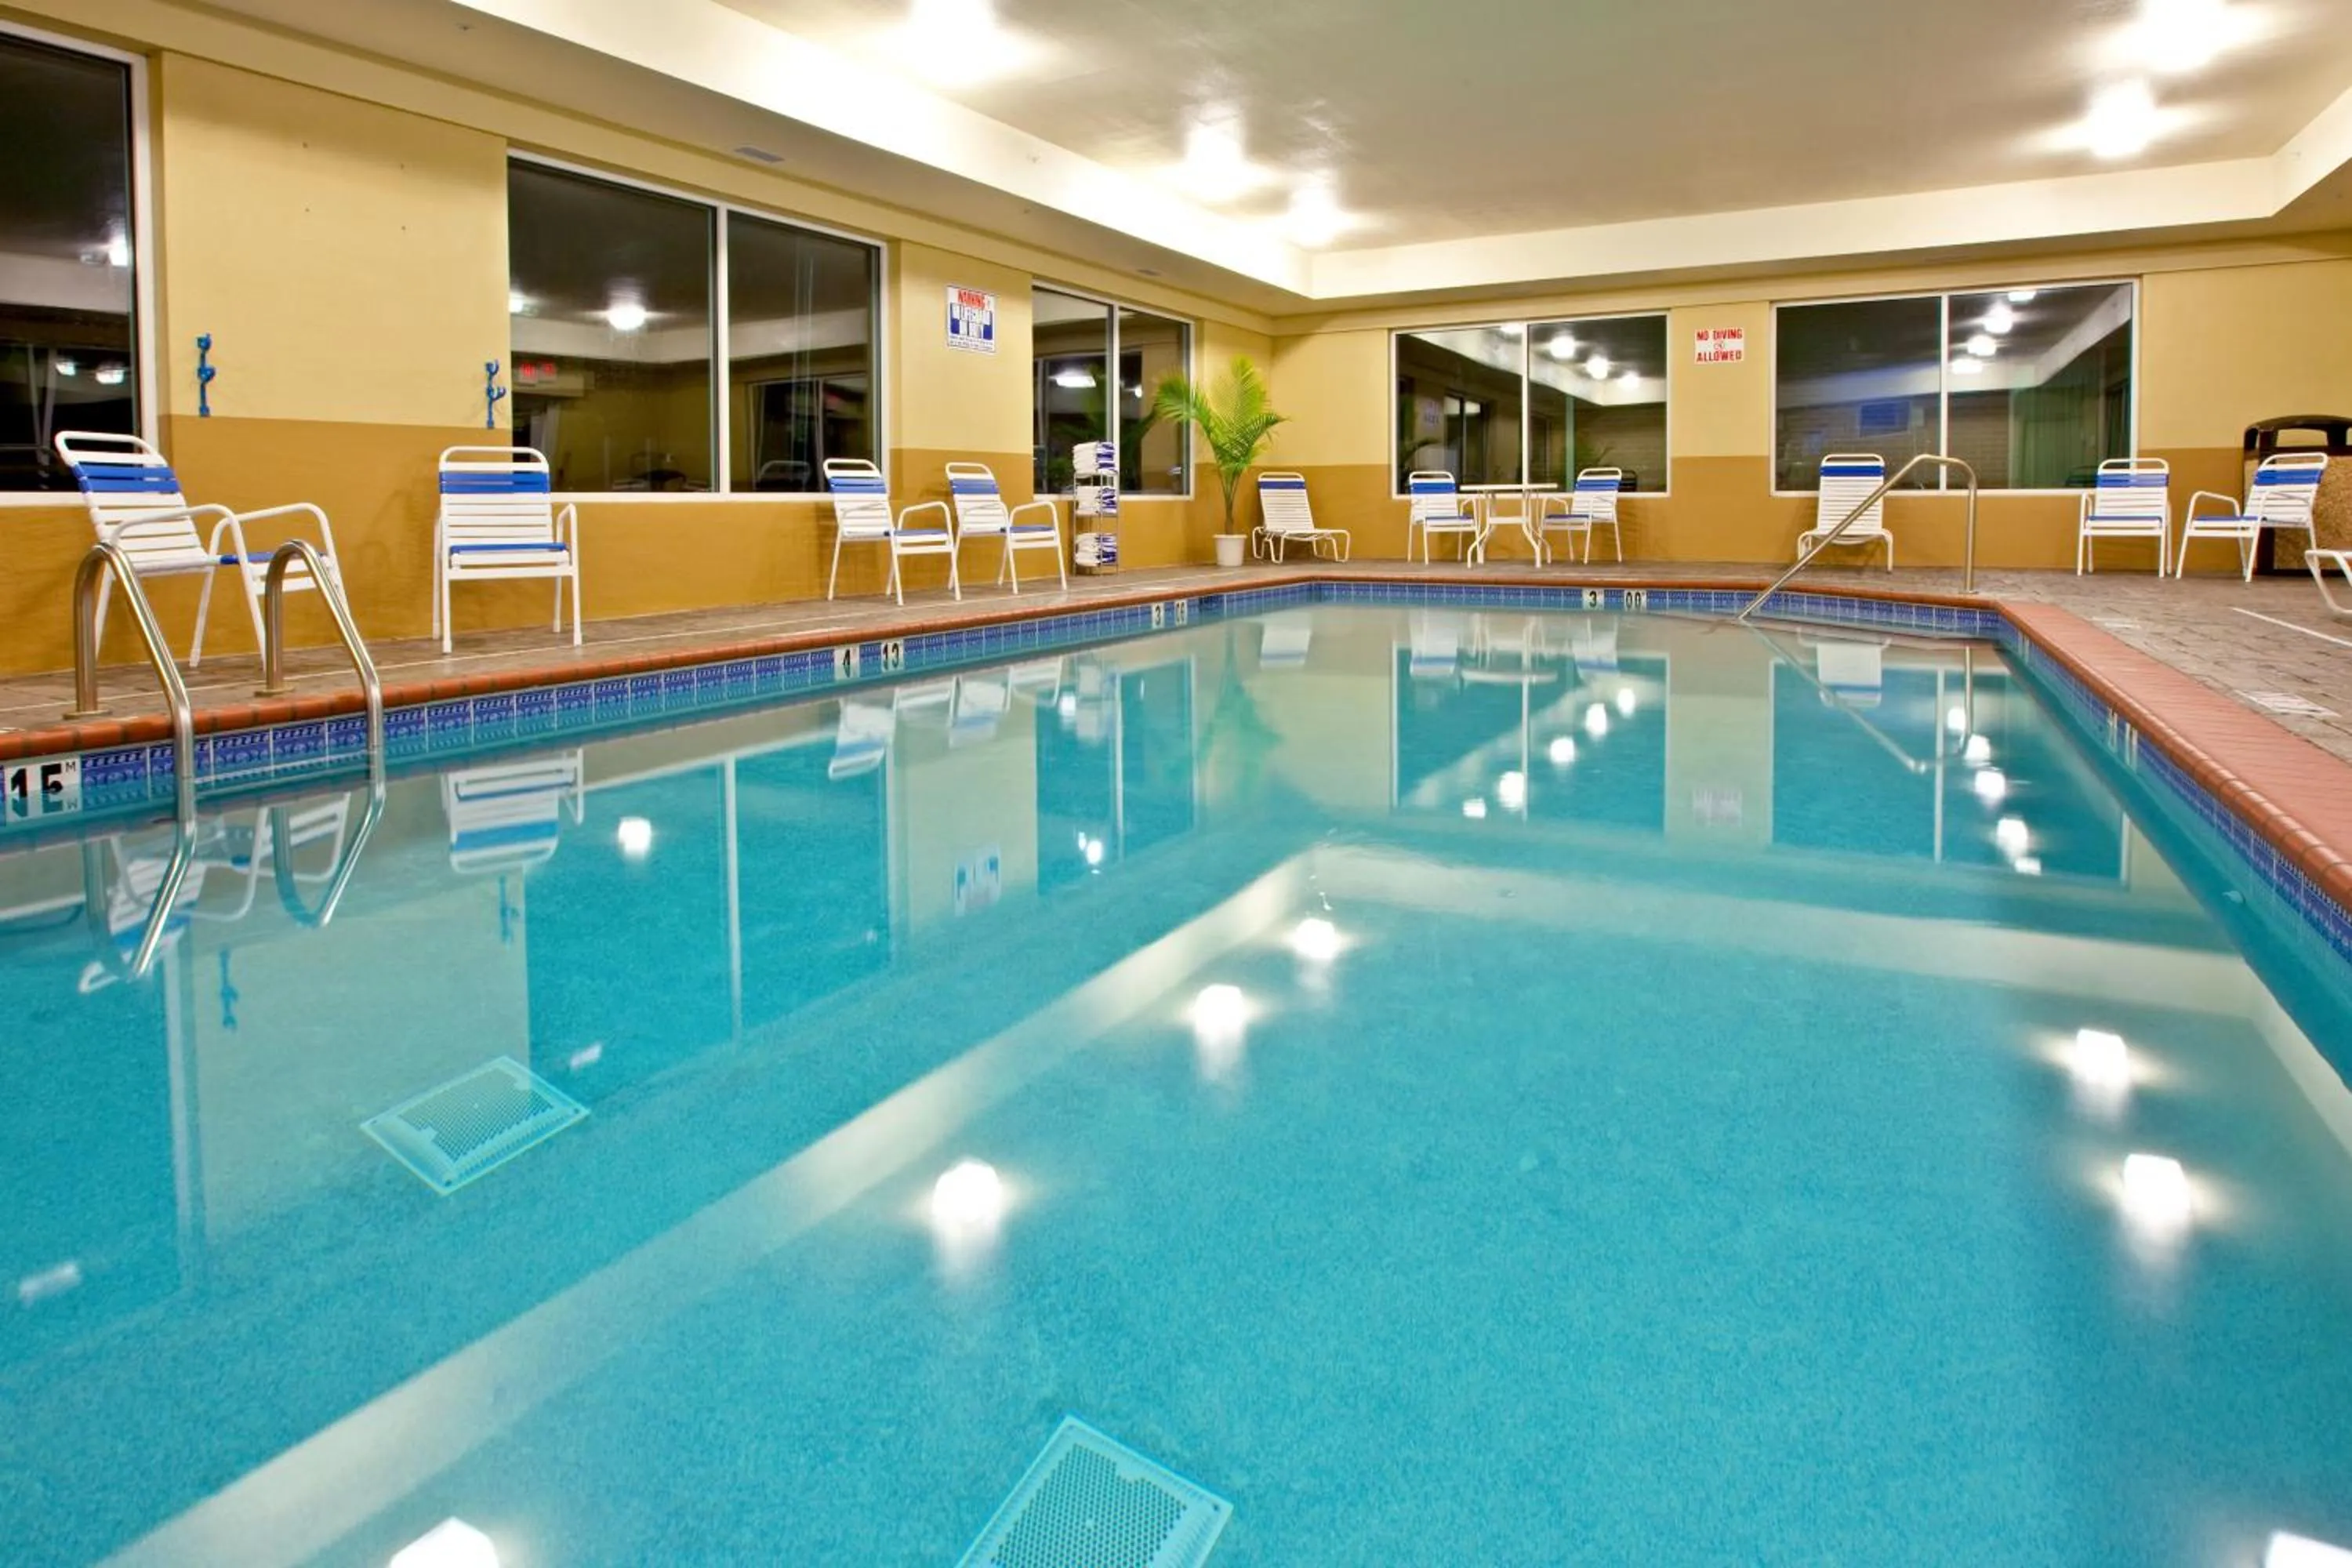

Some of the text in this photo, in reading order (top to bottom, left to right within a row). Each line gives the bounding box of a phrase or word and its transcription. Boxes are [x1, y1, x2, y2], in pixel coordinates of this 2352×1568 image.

[1697, 328, 1743, 341] NO DIVING
[1696, 350, 1742, 362] ALLOWED
